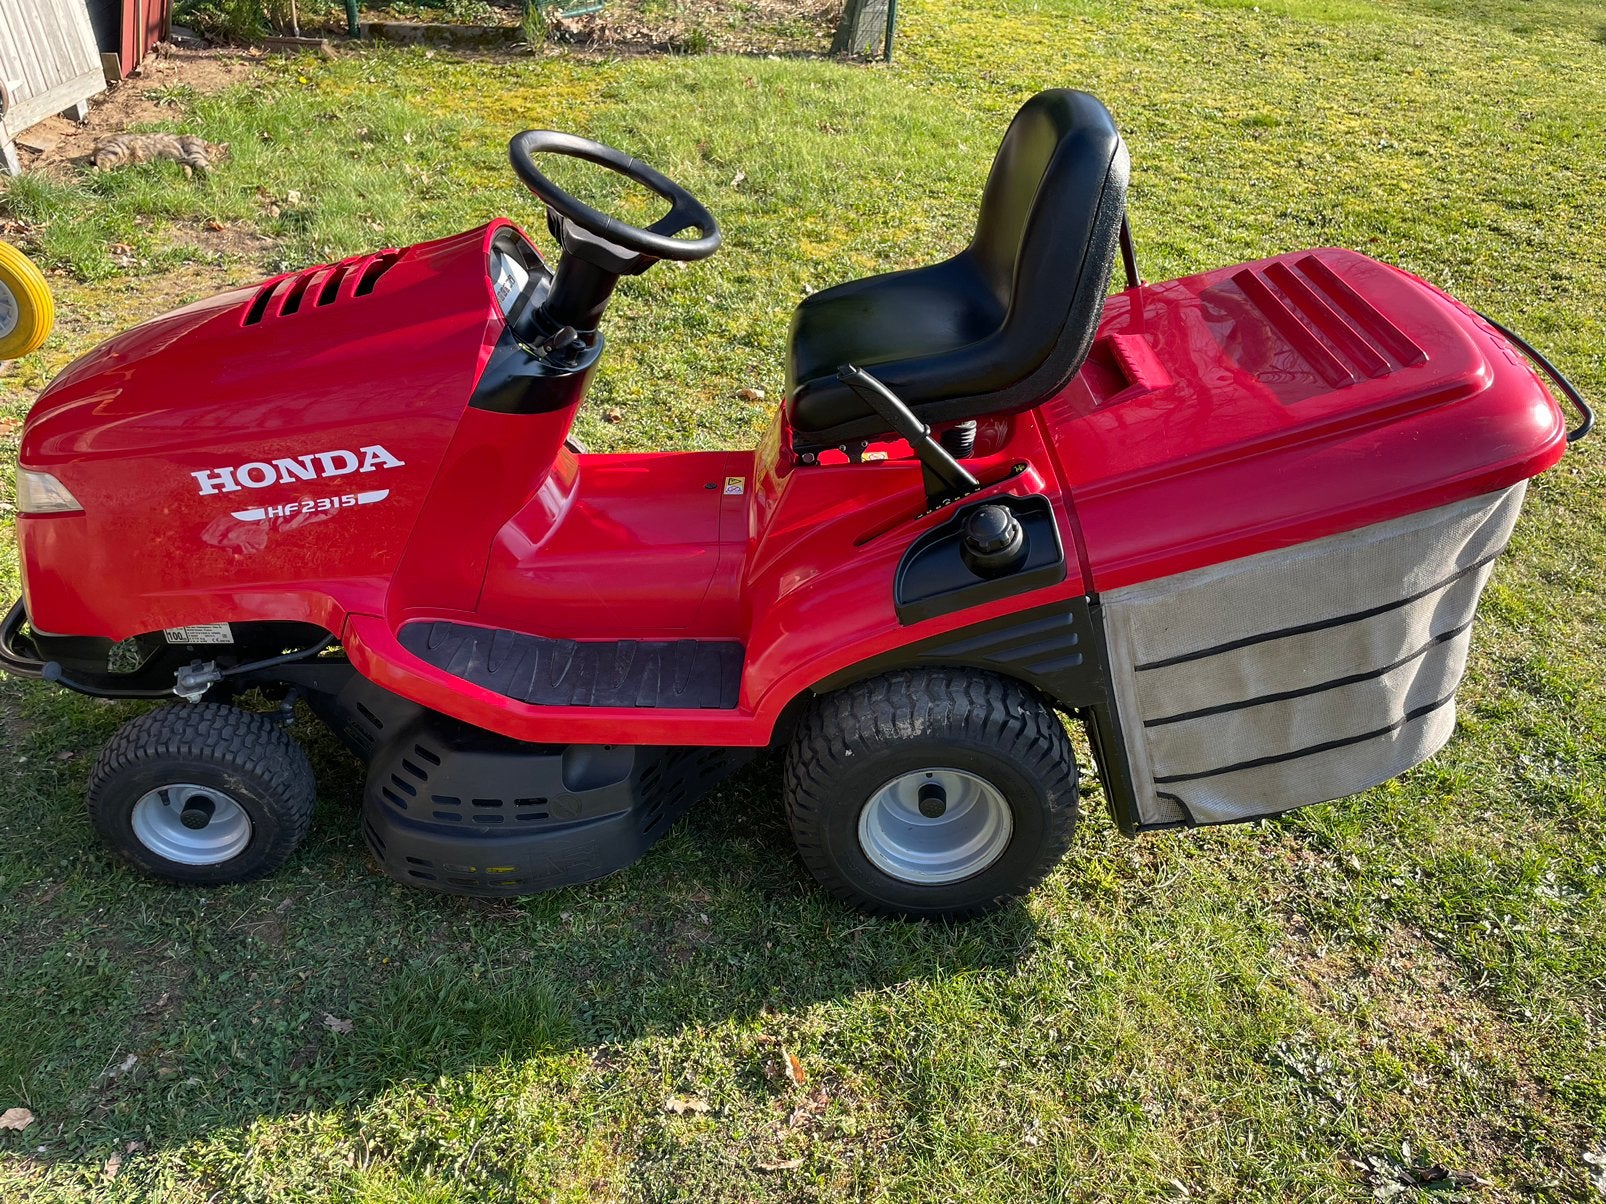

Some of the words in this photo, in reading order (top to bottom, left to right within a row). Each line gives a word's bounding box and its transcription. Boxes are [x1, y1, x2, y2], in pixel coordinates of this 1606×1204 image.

[190, 444, 405, 496] HONDA
[267, 494, 357, 518] HF2315
[167, 631, 183, 641] 100
